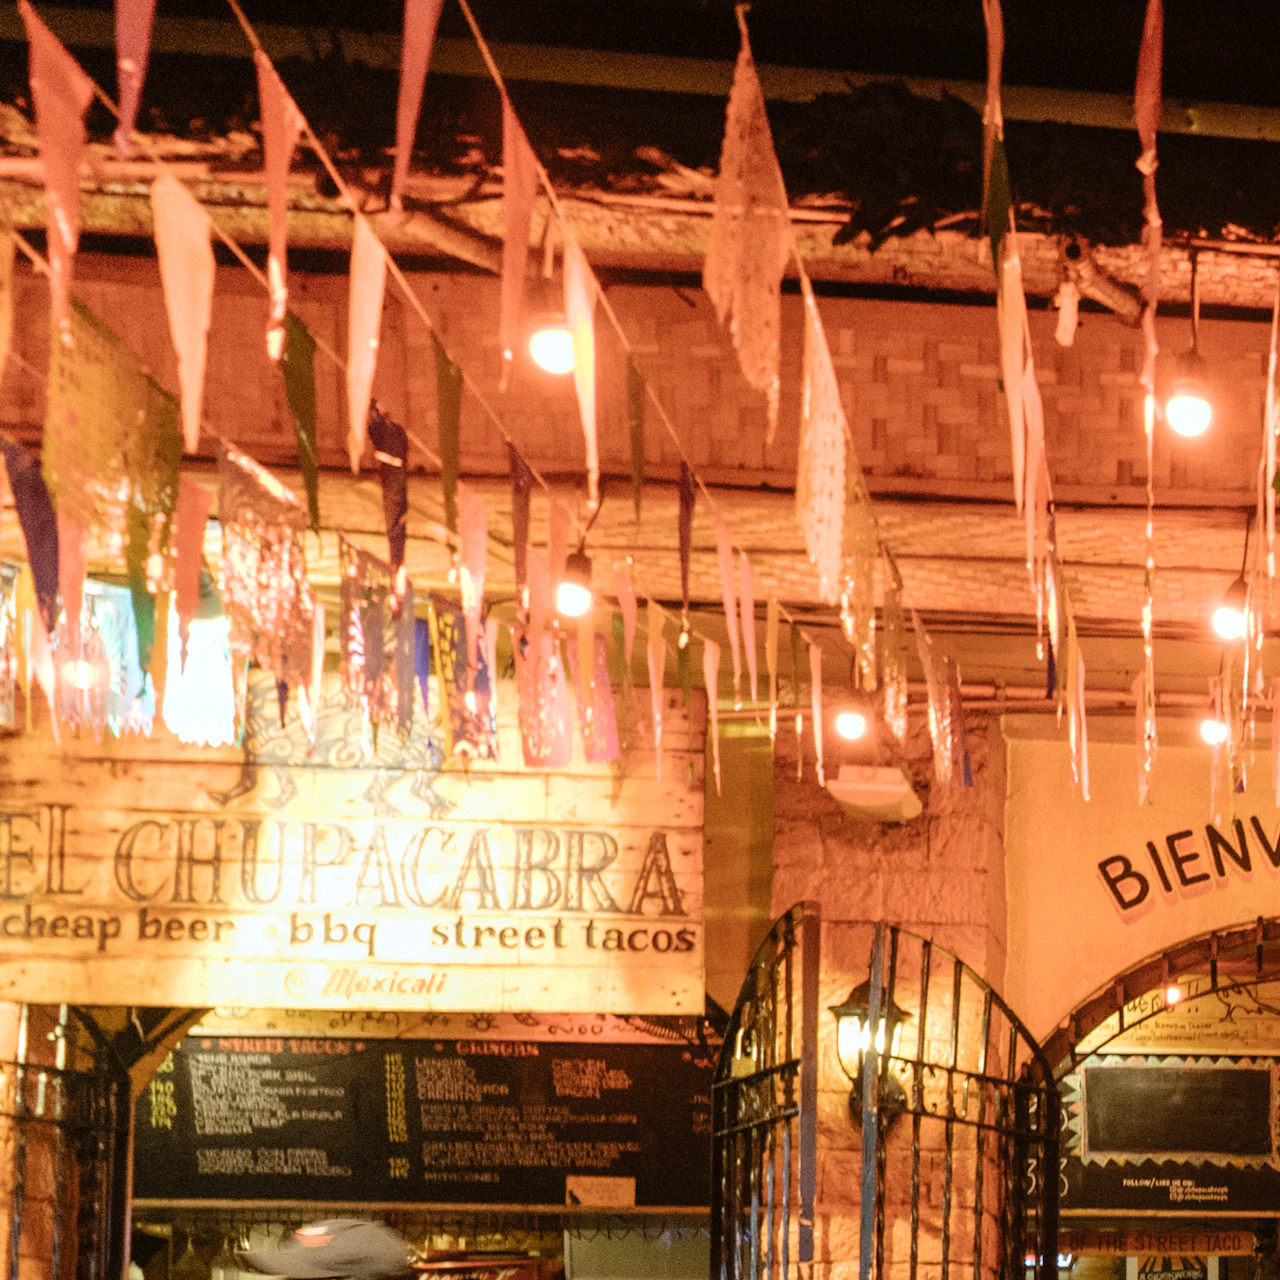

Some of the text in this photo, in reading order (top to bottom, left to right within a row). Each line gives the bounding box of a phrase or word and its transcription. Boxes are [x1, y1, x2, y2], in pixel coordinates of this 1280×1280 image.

[0, 803, 690, 918] EL CHUPACABRA
[2, 903, 696, 957] cheap beer bbq street tacos
[320, 967, 448, 1000] Mexicali
[1070, 1234, 1241, 1251] OF THE STREET TACO
